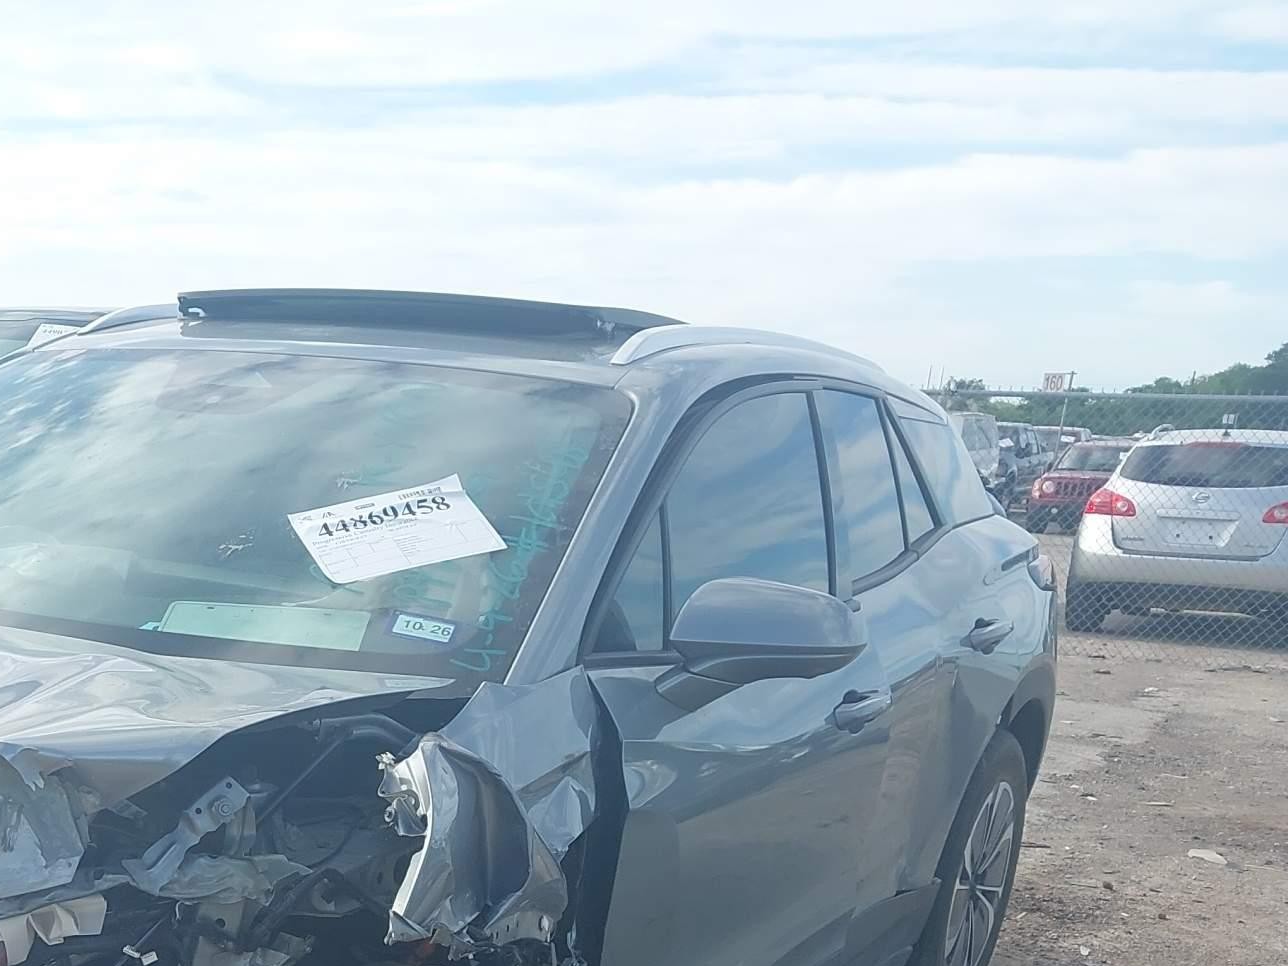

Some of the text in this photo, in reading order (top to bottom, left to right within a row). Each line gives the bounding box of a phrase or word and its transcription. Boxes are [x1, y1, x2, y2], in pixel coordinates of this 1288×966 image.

[1044, 375, 1064, 391] 160
[318, 495, 451, 536] 44869458
[404, 620, 452, 637] 10 26
